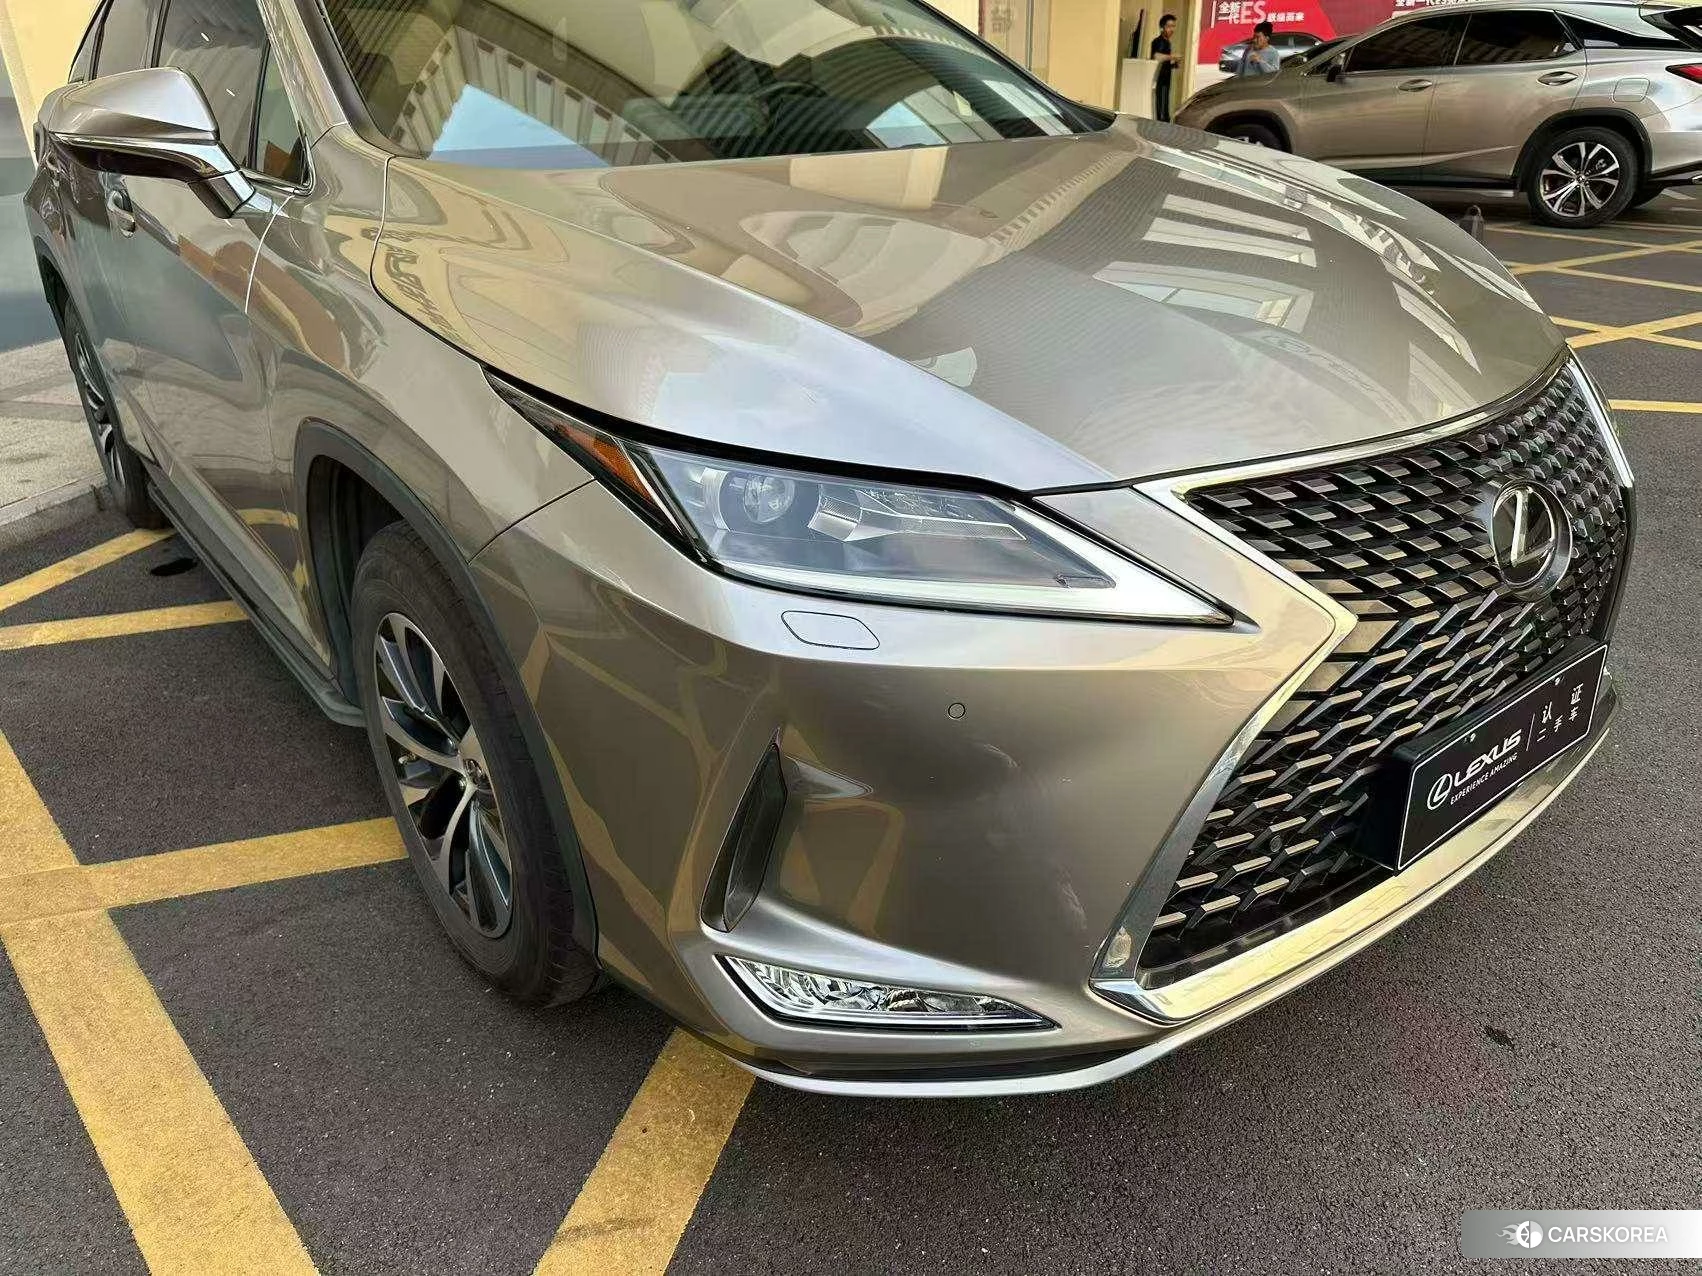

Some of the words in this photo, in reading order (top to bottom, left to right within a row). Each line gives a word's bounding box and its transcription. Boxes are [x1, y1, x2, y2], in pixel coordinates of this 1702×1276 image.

[1240, 1, 1267, 24] ES
[1536, 706, 1579, 742] 二手车
[1450, 772, 1490, 805] EXPERIENCE
[1489, 752, 1518, 778] AMAZING
[1453, 728, 1522, 787] LEXUS
